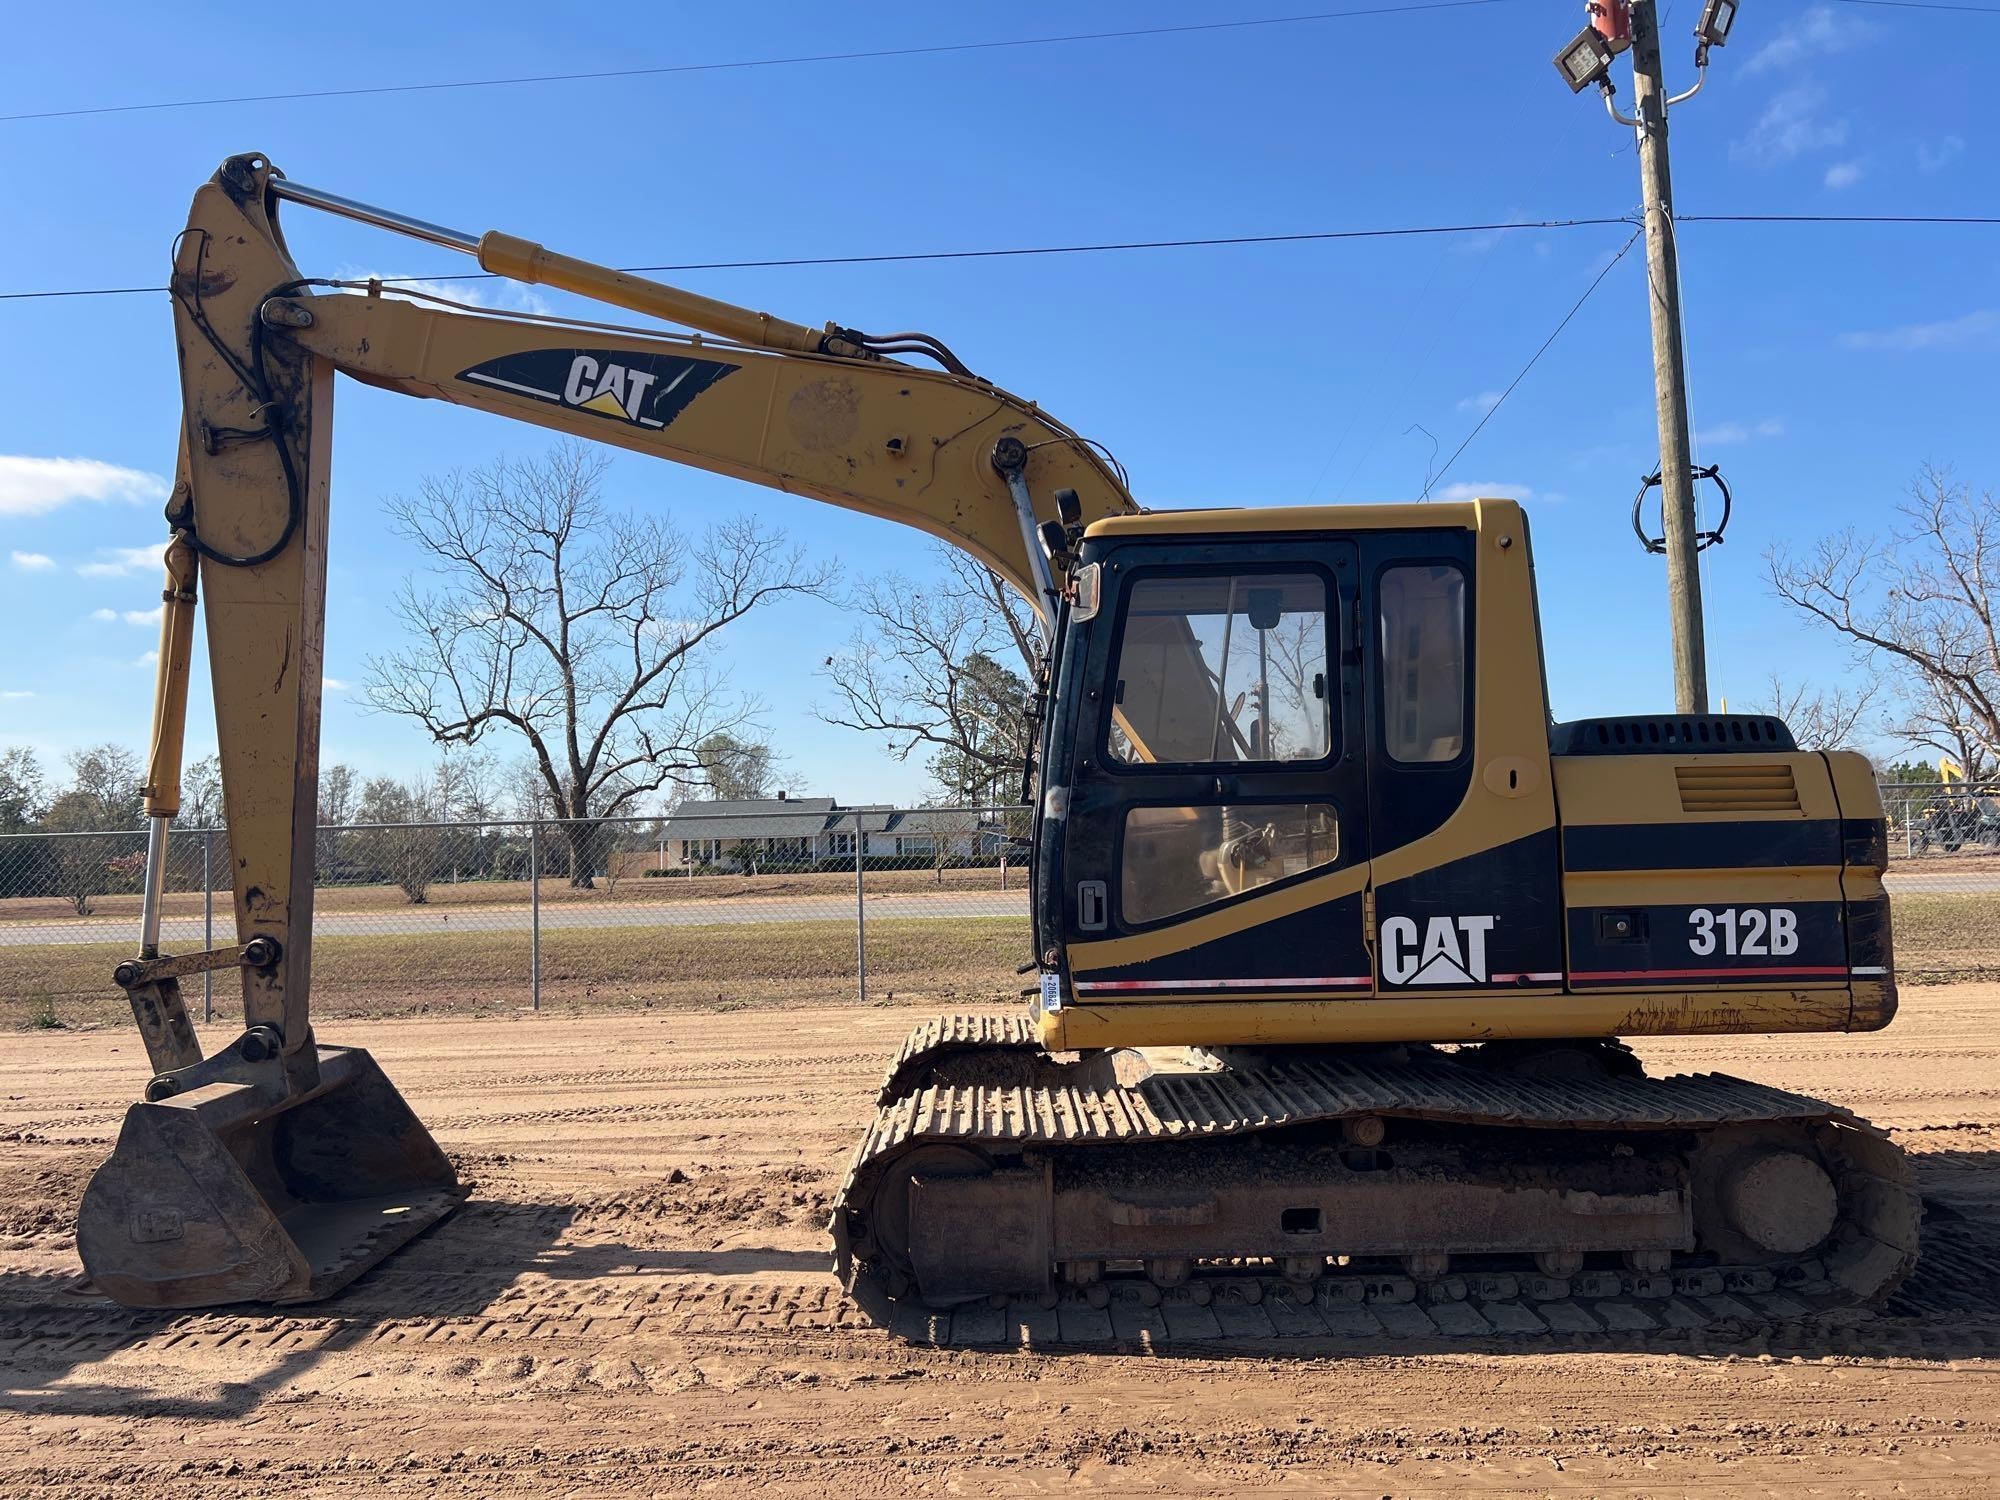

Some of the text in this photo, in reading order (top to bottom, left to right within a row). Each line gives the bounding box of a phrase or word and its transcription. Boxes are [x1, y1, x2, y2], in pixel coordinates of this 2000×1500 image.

[565, 355, 656, 421] CAT
[1381, 915, 1495, 985] CAT
[1688, 908, 1799, 956] 312B
[1047, 982, 1058, 1007] 206825
